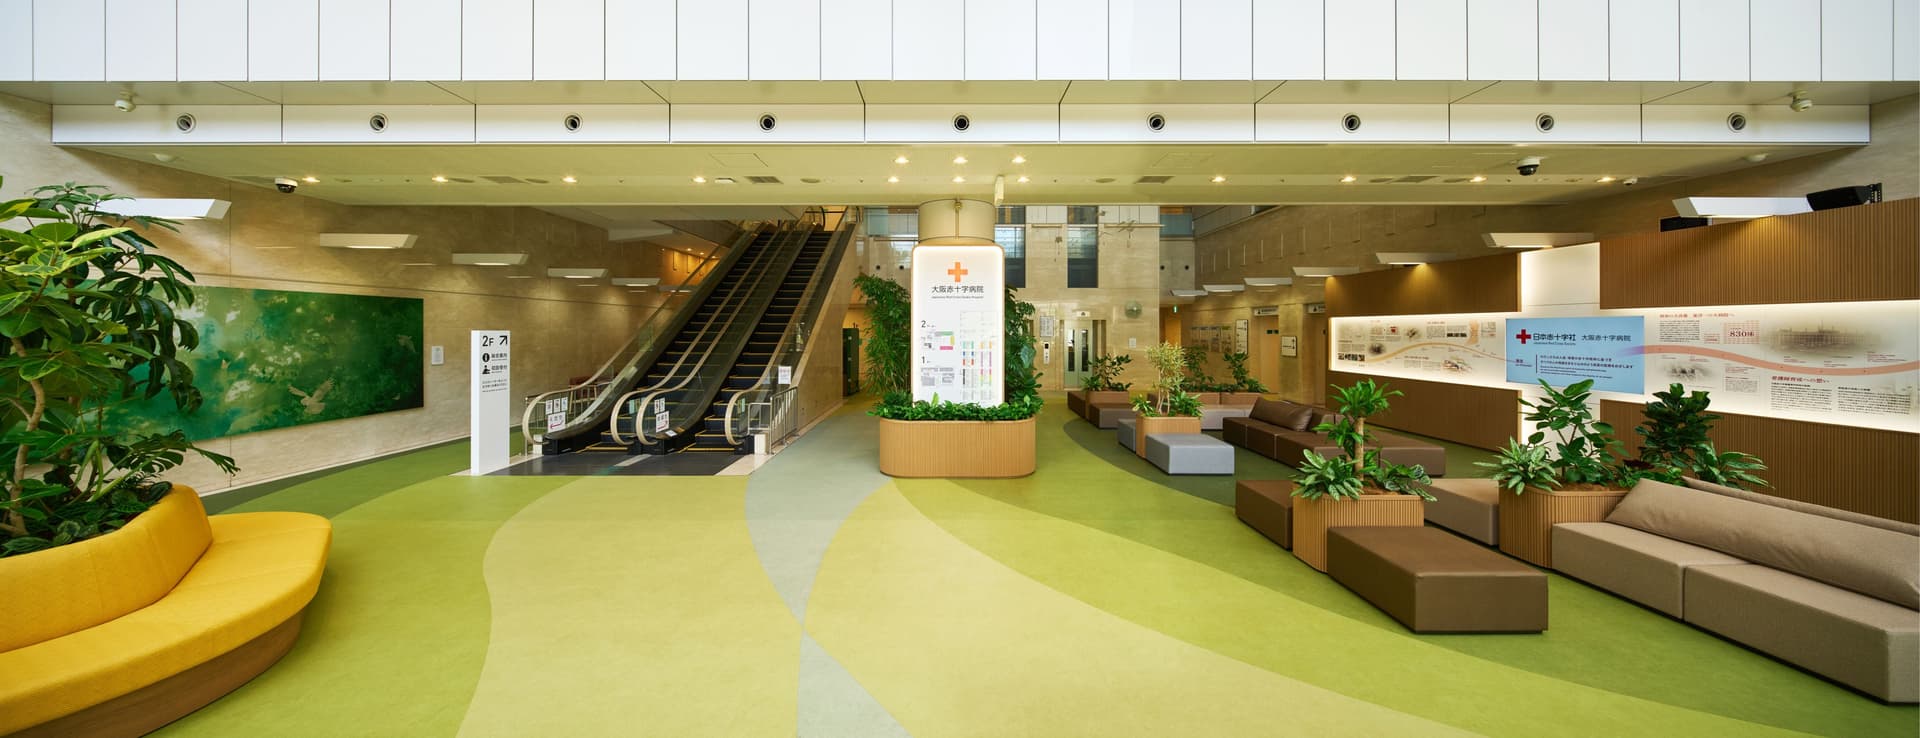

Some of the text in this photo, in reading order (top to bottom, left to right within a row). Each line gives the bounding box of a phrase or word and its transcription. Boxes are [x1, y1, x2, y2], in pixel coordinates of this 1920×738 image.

[921, 320, 927, 328] 2
[482, 335, 494, 346] 2F
[1533, 333, 1576, 342] 日本赤十字社
[1581, 334, 1631, 342] 大阪赤十字病院
